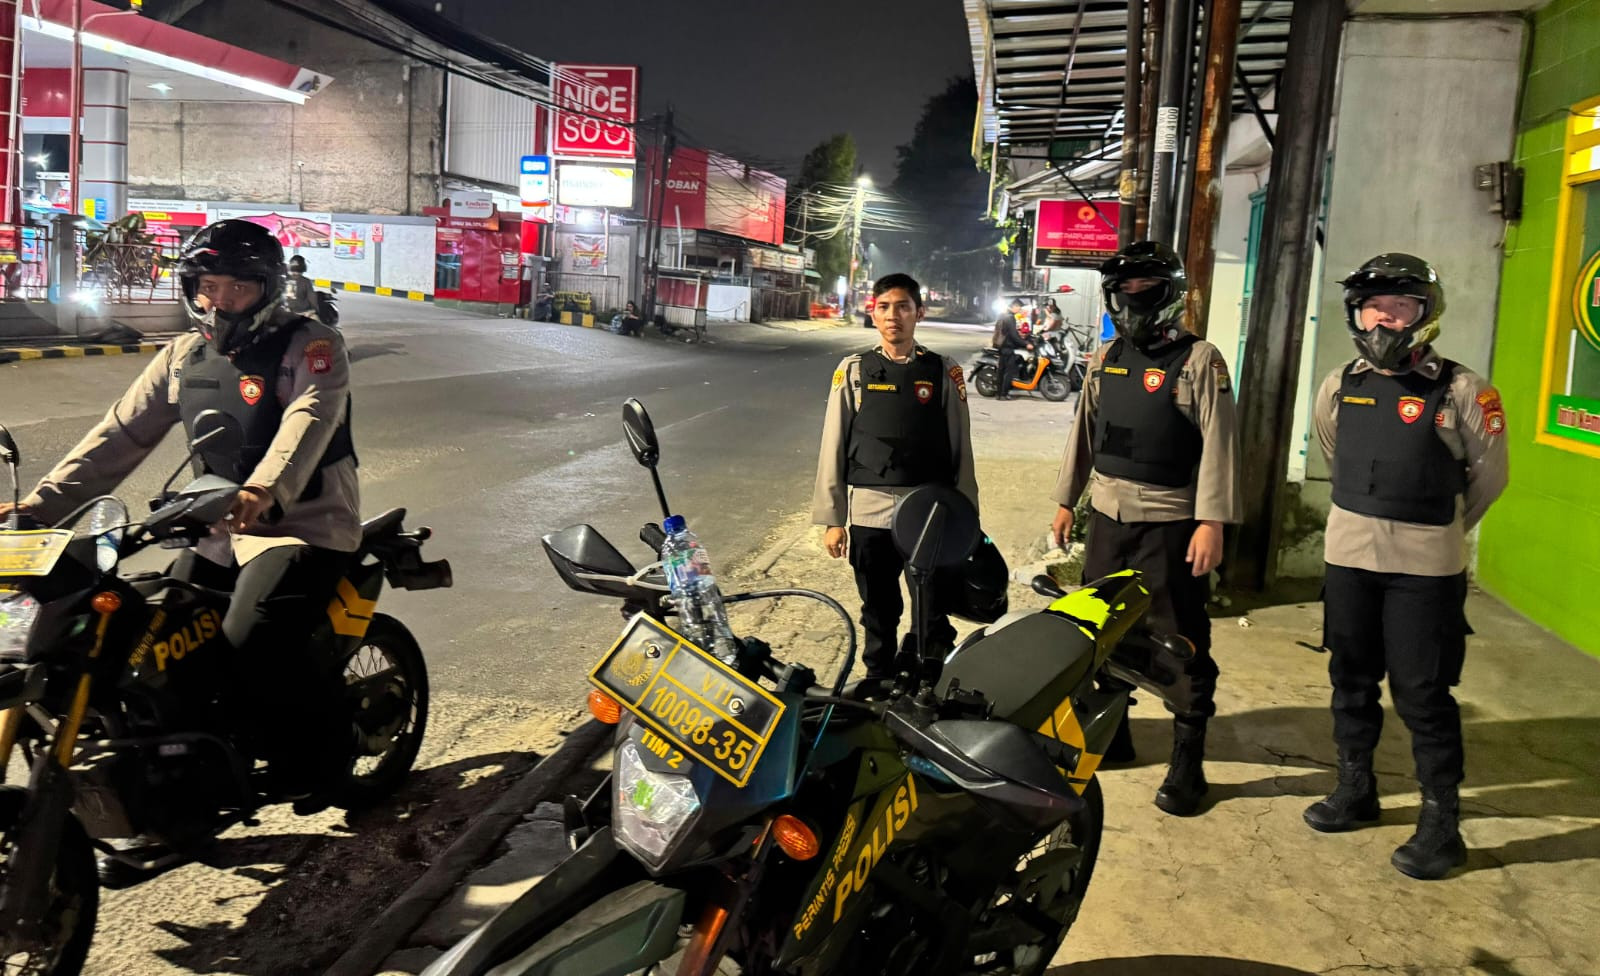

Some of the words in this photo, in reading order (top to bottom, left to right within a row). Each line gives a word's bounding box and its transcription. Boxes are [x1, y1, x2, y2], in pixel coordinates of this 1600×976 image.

[654, 178, 700, 190] POBAN
[640, 728, 671, 759] TIM
[667, 750, 684, 769] 2
[649, 687, 754, 770] 10098-35
[833, 772, 919, 924] POLISI
[794, 868, 836, 940] PERINTIS
